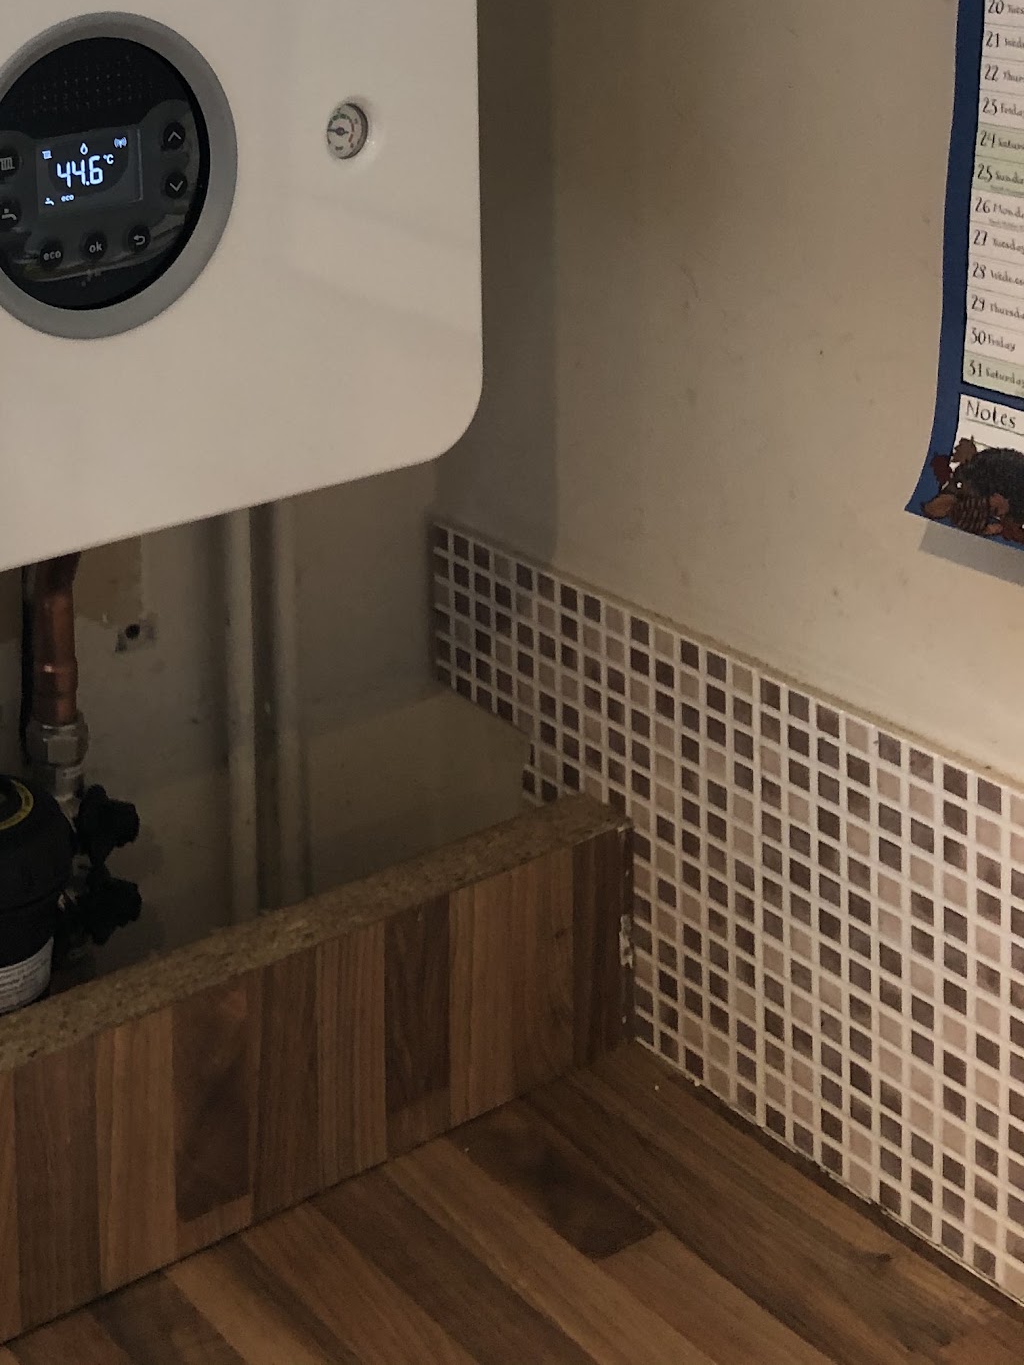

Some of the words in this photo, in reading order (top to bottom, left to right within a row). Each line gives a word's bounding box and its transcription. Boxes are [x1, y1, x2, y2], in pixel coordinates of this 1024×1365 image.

[986, 31, 999, 47] 21
[984, 63, 999, 82] 22
[982, 97, 997, 115] 23
[980, 130, 995, 148] 24
[57, 155, 103, 188] 44.6
[978, 163, 992, 182] 25
[976, 197, 990, 213] 26
[974, 229, 987, 246] 27
[43, 251, 61, 261] eco
[89, 241, 102, 253] ok
[972, 261, 986, 279] 28
[971, 295, 985, 312] 29
[971, 327, 986, 345] 30
[969, 360, 982, 377] 31
[966, 400, 1016, 429] Notes
